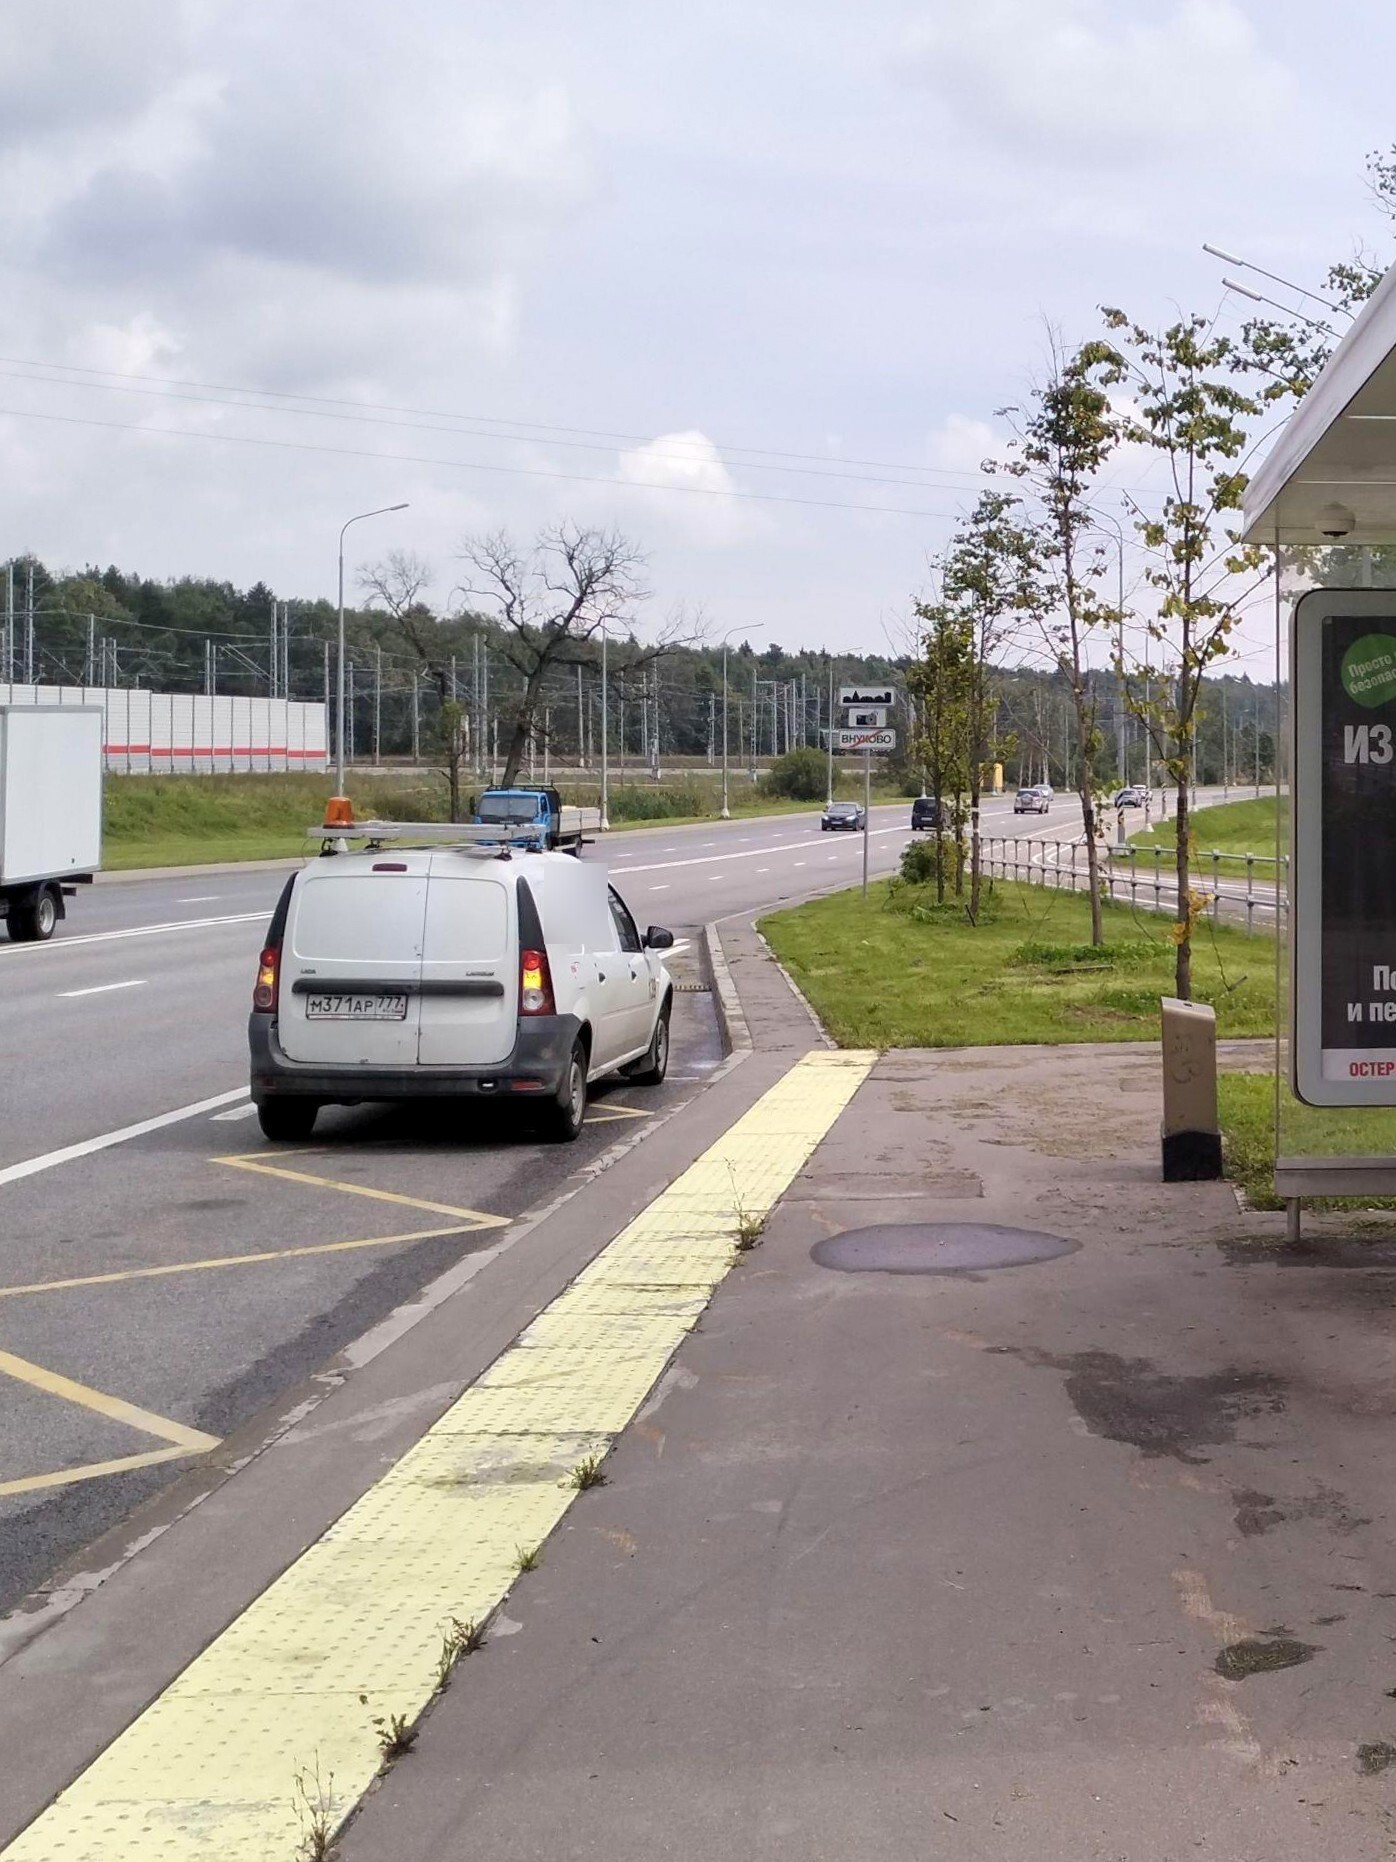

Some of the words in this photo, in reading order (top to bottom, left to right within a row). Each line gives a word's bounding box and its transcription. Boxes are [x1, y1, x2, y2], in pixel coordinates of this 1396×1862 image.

[1348, 654, 1393, 678] Просто
[841, 734, 892, 744] ВНУКОВО
[1343, 723, 1394, 765] ИЗ
[1348, 1002, 1363, 1022] и
